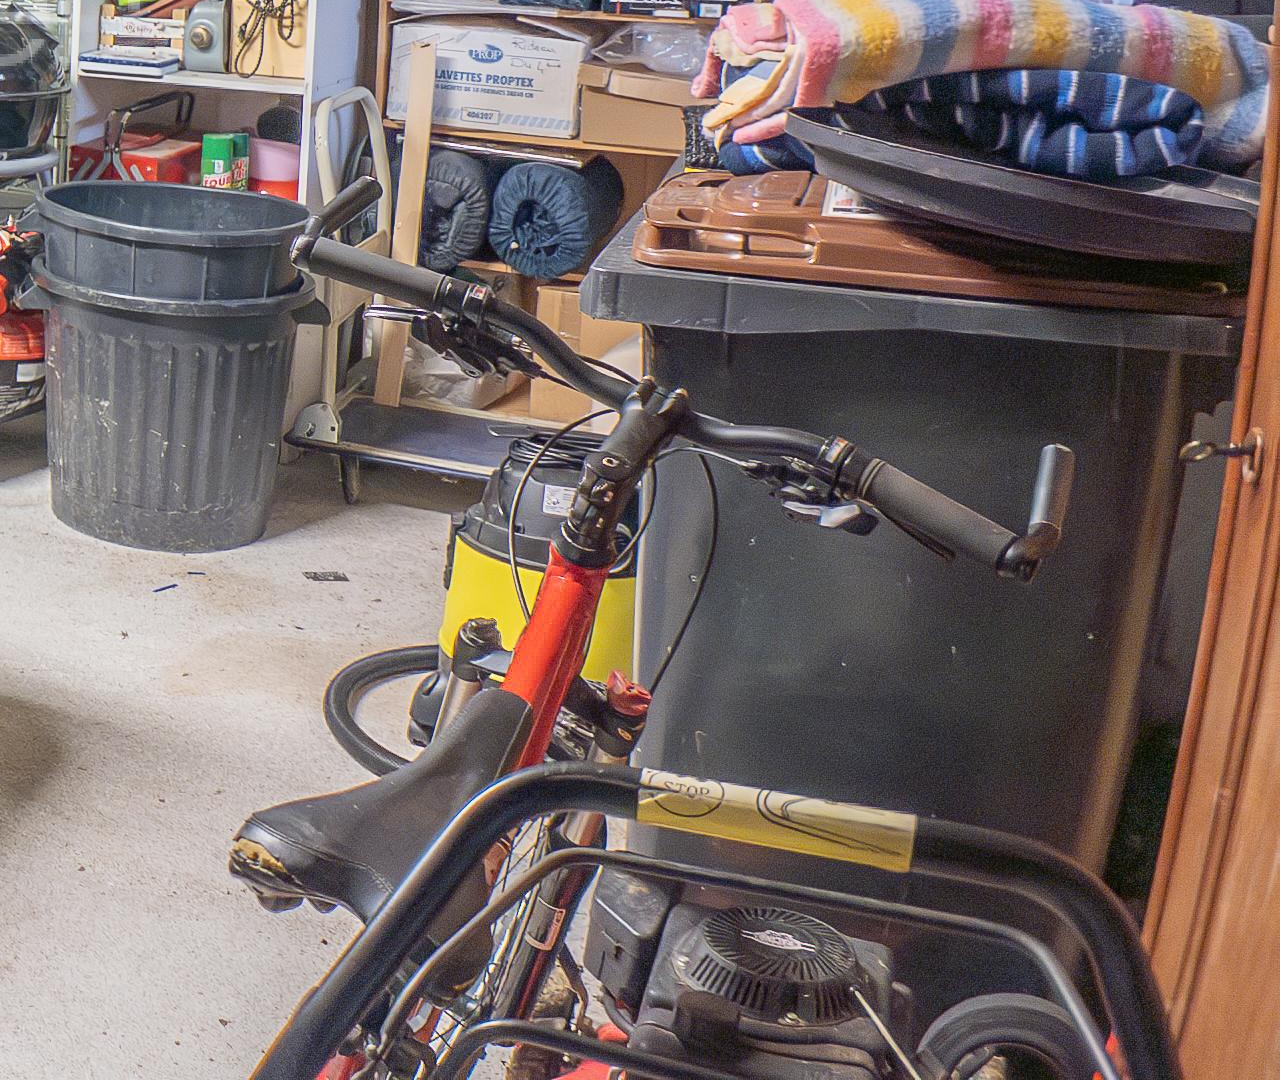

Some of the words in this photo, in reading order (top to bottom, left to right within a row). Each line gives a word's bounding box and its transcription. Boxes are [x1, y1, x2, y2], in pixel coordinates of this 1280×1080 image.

[472, 48, 502, 60] PROP
[435, 68, 483, 83] LAVETTES
[485, 73, 534, 88] PROPTEX
